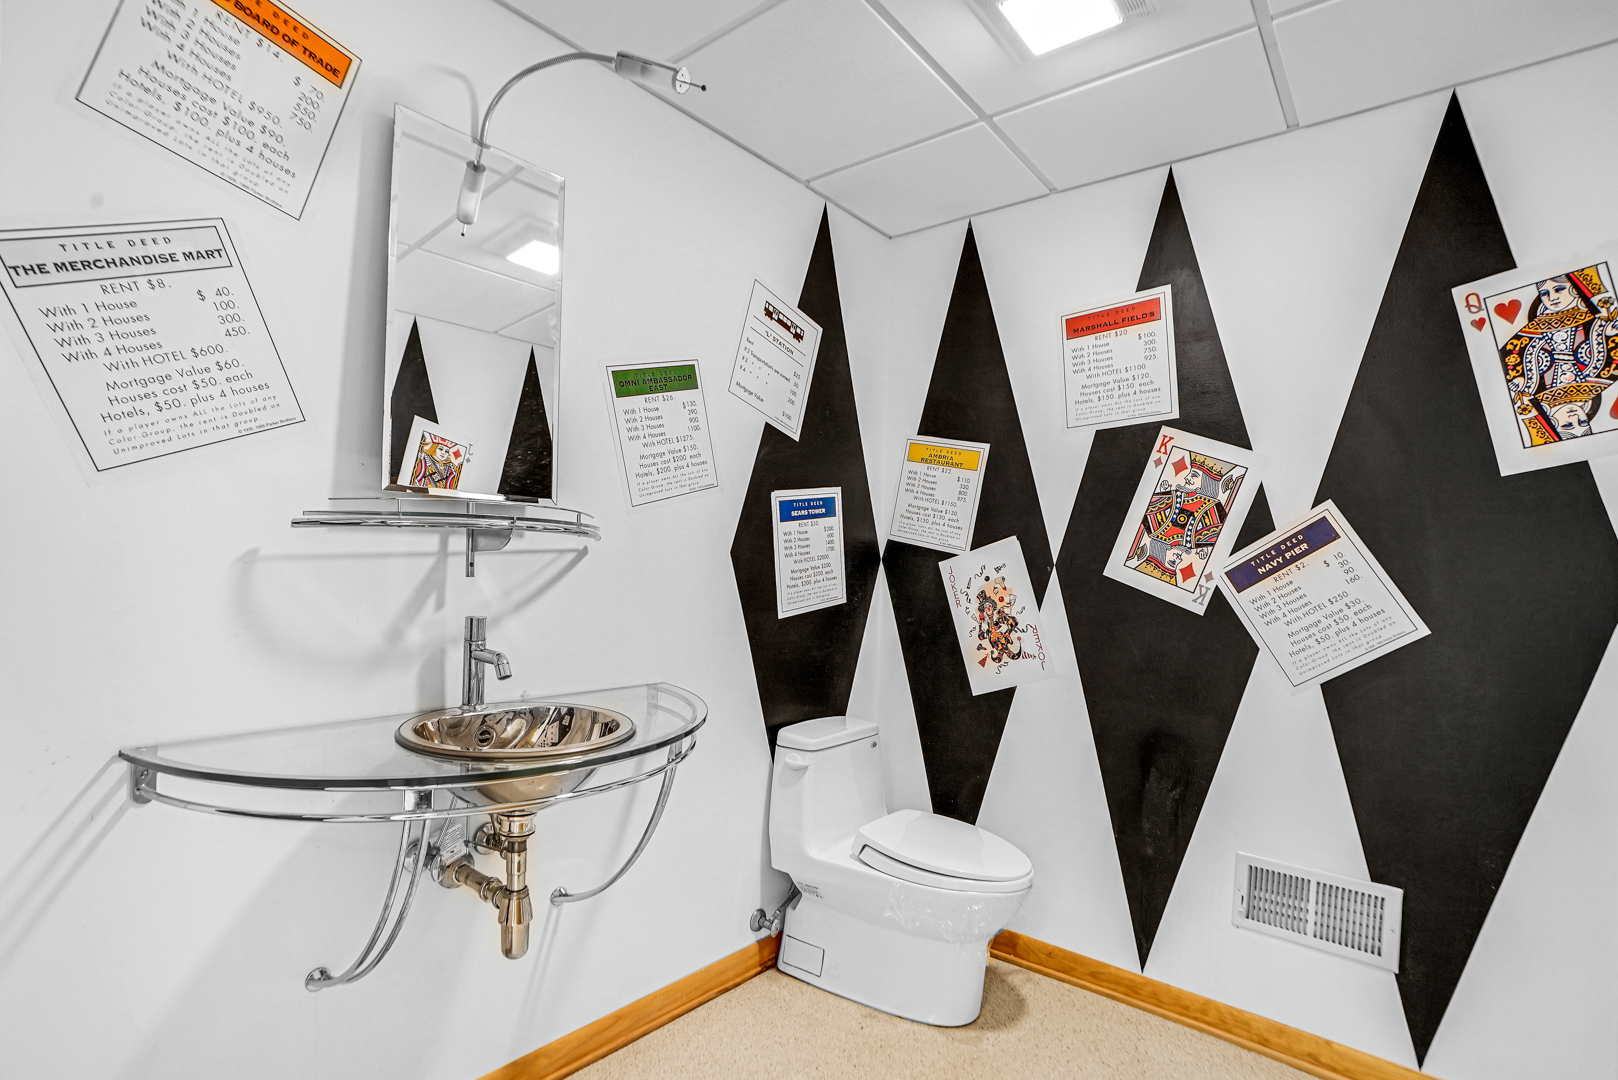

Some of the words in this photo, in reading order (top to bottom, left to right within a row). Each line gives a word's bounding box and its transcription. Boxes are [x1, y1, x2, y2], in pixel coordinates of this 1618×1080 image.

[233, 1, 280, 35] BOARD
[282, 33, 300, 47] OF
[302, 45, 341, 78] TRADE
[272, 11, 309, 39] DEED
[58, 241, 115, 252] TITLE
[127, 237, 171, 247] DEED
[7, 263, 51, 276] THE
[52, 252, 180, 273] MERCHANDISE
[182, 248, 223, 261] MART
[100, 281, 140, 295] RENT
[146, 278, 171, 291] $8.
[38, 304, 77, 318] With
[81, 303, 89, 313] 1
[94, 301, 137, 312] House
[196, 289, 206, 302] $
[215, 287, 234, 297] 40.
[46, 319, 84, 333] With
[87, 318, 97, 328] 2
[101, 314, 150, 326] Houses
[213, 300, 239, 311] 100.
[1465, 292, 1484, 314] Q
[53, 334, 91, 348] With
[95, 332, 105, 343] 3
[108, 328, 157, 341] Houses
[217, 313, 245, 325] 300.
[61, 348, 98, 363] With
[104, 347, 112, 356] 4
[115, 342, 163, 355] Houses
[225, 326, 250, 337] 450.
[102, 358, 140, 372] With
[141, 350, 187, 366] HOTEL
[190, 344, 229, 359] $600.
[105, 373, 172, 391] Mortgage
[175, 365, 211, 378] Value
[215, 358, 244, 372] $60.
[107, 391, 158, 406] Houses
[162, 383, 188, 396] cost
[191, 376, 221, 390] $50.
[225, 369, 253, 383] each
[100, 406, 150, 423] Hotels,
[154, 398, 186, 413] $50.
[190, 393, 215, 407] plus
[220, 389, 227, 398] 4
[229, 383, 270, 396] houses
[928, 453, 954, 461] AMBRIA
[1156, 434, 1174, 455] K
[920, 457, 963, 468] RESTAURANT
[791, 509, 808, 517] SEARS
[1250, 550, 1276, 566] TITLE
[1280, 535, 1303, 550] DEED
[1257, 556, 1283, 575] NAVY
[1284, 543, 1309, 559] PIER
[948, 565, 962, 608] JOKER
[1249, 594, 1266, 605] With
[1272, 580, 1294, 593] House
[1323, 560, 1330, 568] $
[1273, 568, 1293, 583] RENT
[1192, 584, 1211, 606] K
[1253, 601, 1271, 612] With
[1277, 586, 1302, 601] Houses
[1258, 608, 1276, 619] With
[1282, 593, 1307, 608] Houses
[1263, 615, 1281, 627] With
[1287, 601, 1312, 615] Houses
[1283, 615, 1303, 627] With
[1302, 602, 1327, 618] HOTEL
[1287, 619, 1322, 639] Mortgage
[1322, 608, 1344, 620] Value
[1290, 632, 1316, 647] Houses
[1317, 623, 1333, 634] cost
[1353, 603, 1372, 616] each
[1030, 624, 1046, 671] JOKER
[1288, 644, 1314, 658] Hotels,
[1334, 626, 1350, 638] plus
[1357, 609, 1386, 624] houses
